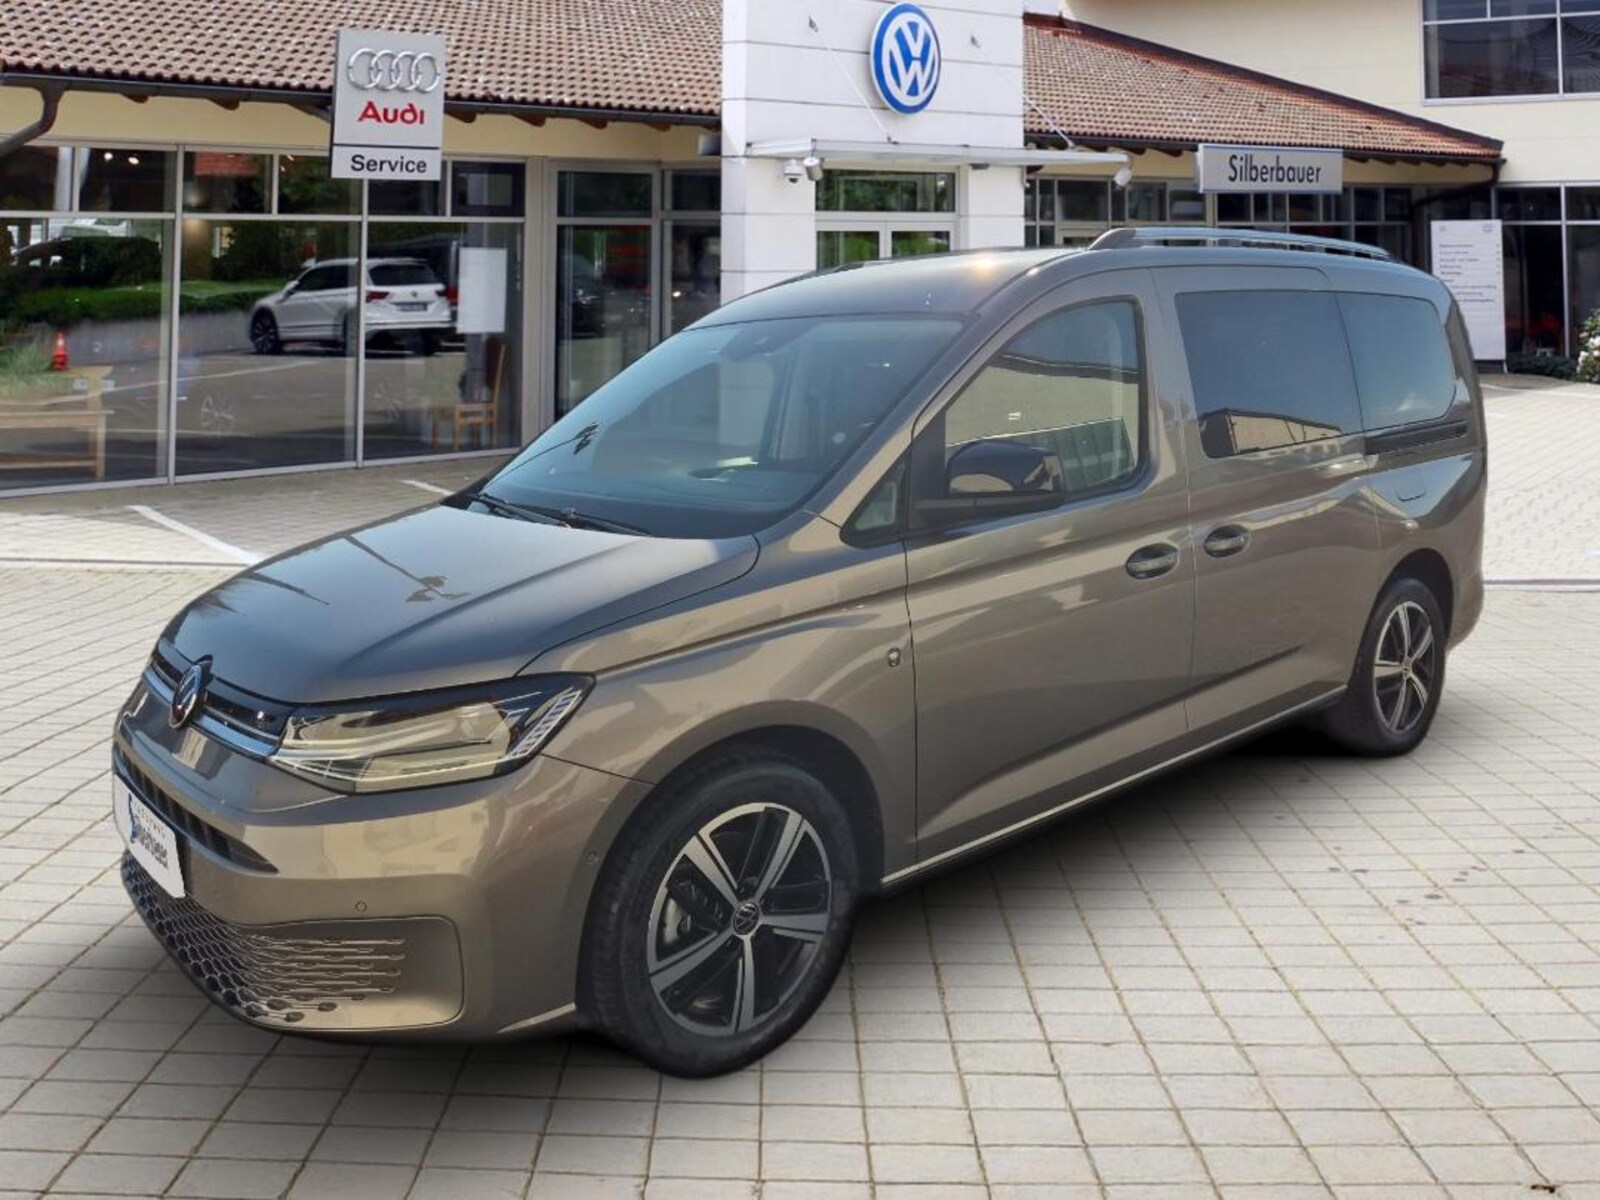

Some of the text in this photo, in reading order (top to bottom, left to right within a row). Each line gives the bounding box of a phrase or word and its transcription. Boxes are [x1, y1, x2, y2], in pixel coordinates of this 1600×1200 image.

[880, 10, 938, 107] VW
[357, 100, 425, 125] Audi
[350, 154, 427, 173] Service
[1228, 154, 1321, 183] Silberbauer
